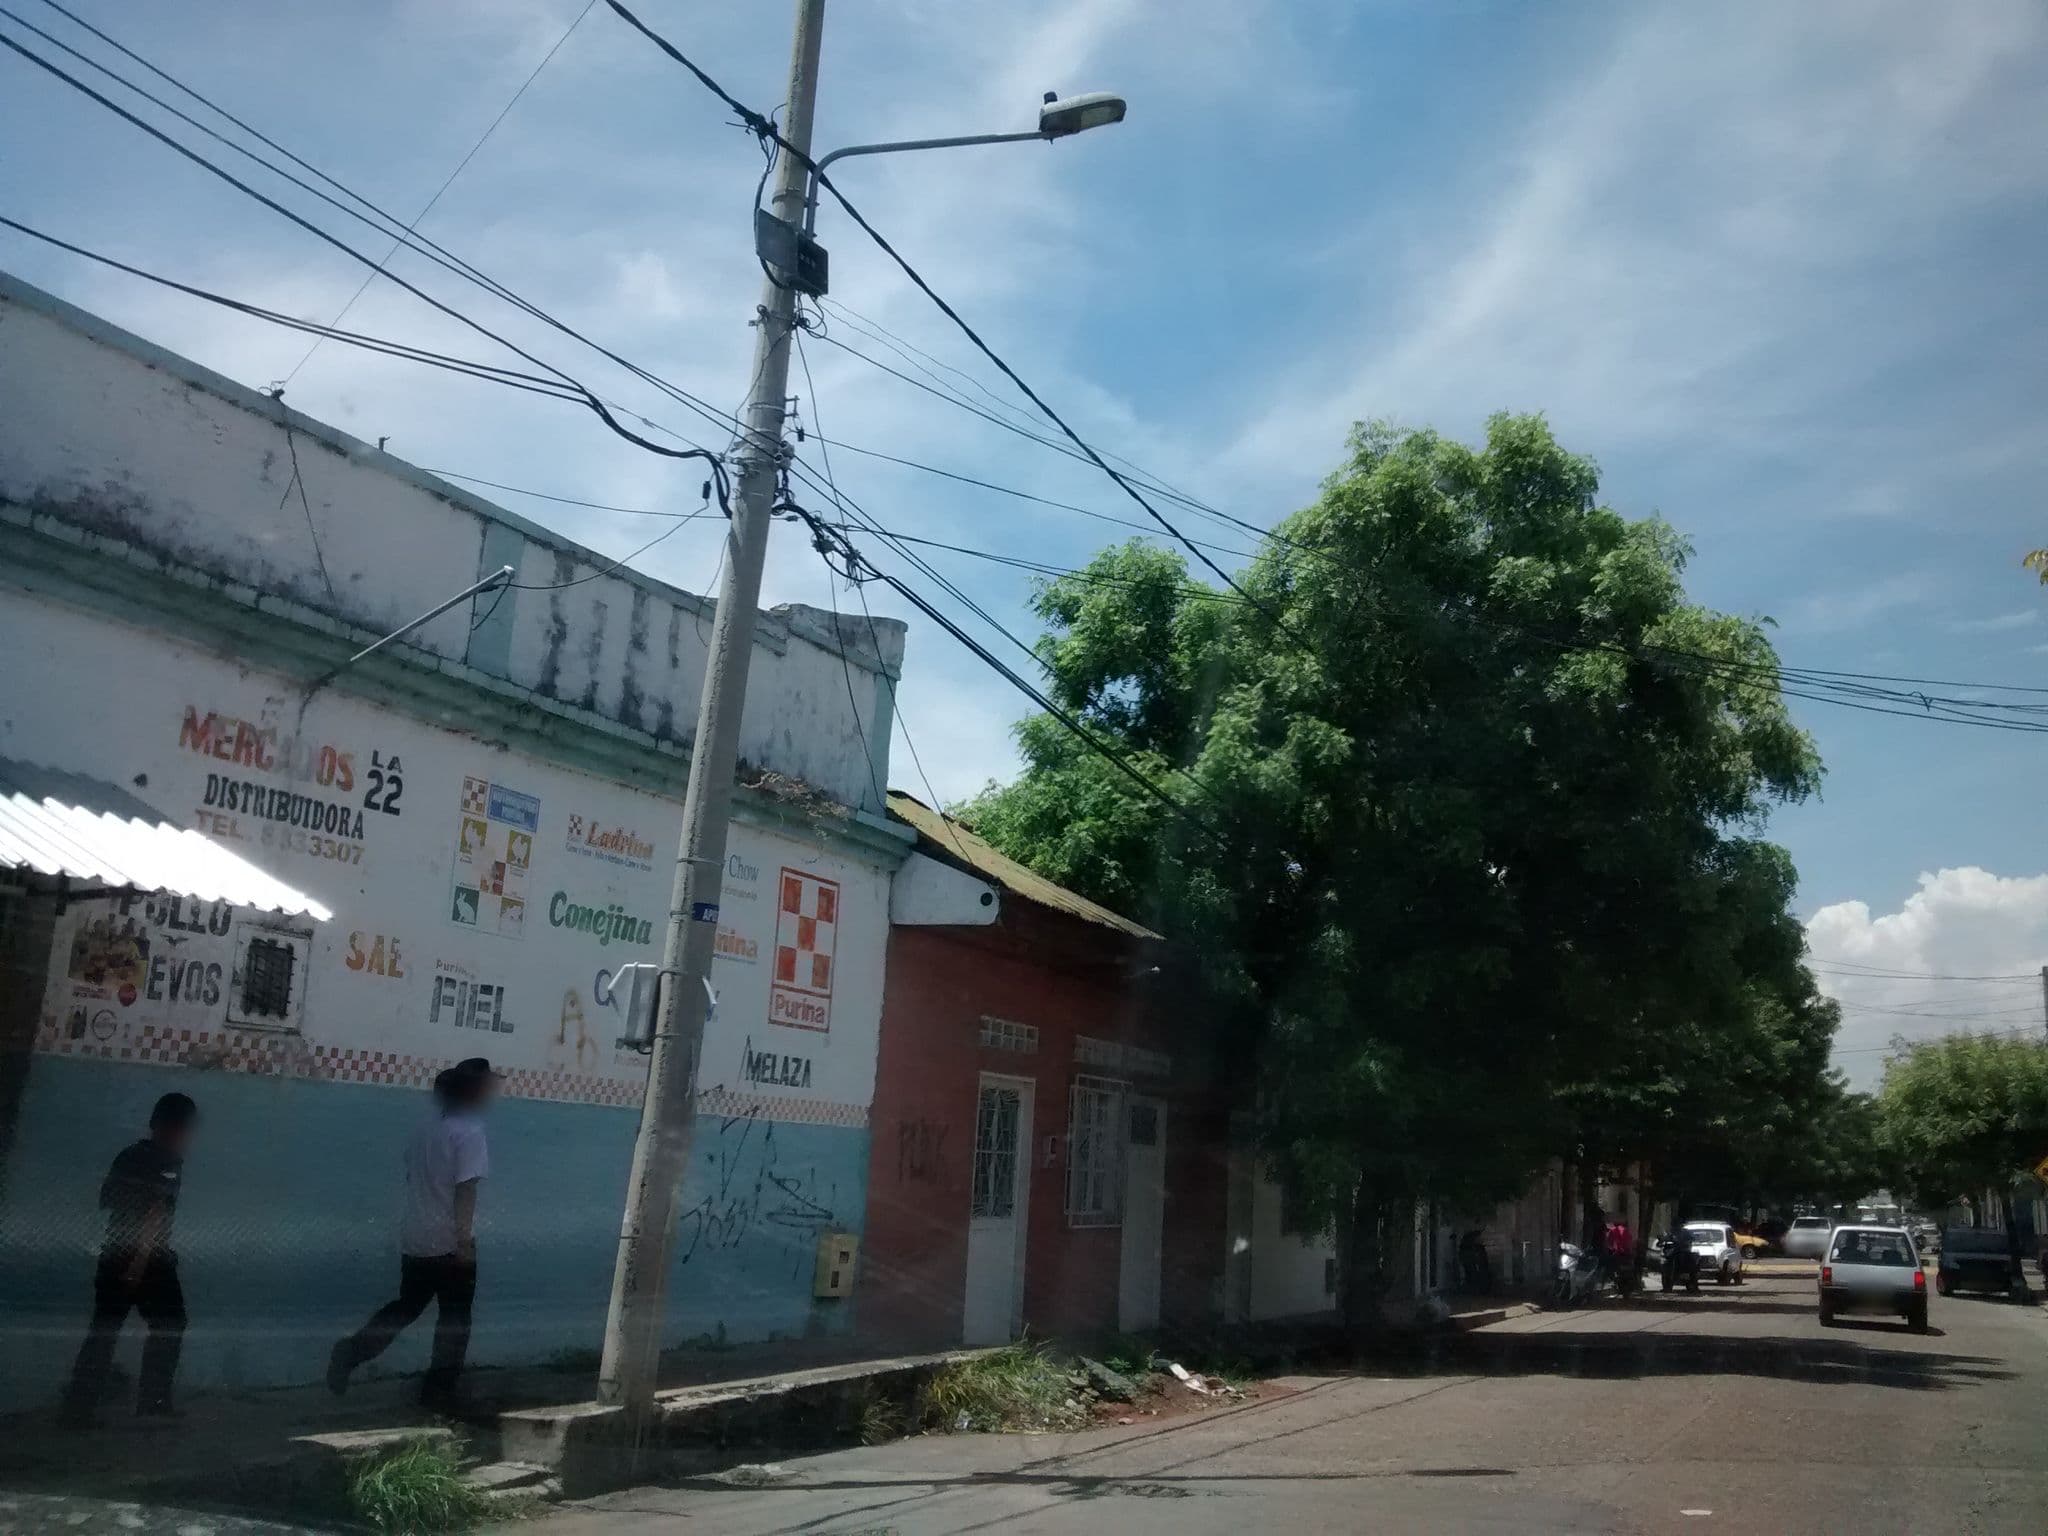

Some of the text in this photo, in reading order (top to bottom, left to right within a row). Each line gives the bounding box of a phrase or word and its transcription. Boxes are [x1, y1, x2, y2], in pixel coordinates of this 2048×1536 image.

[371, 750, 403, 774] LA
[203, 773, 364, 840] DISTRIBUIDORA
[363, 769, 403, 816] 22
[728, 854, 760, 882] Chow
[549, 890, 654, 947] Conejina
[429, 975, 515, 1034] FIEL
[774, 993, 826, 1024] Purina
[745, 1050, 812, 1088] MELAZA
